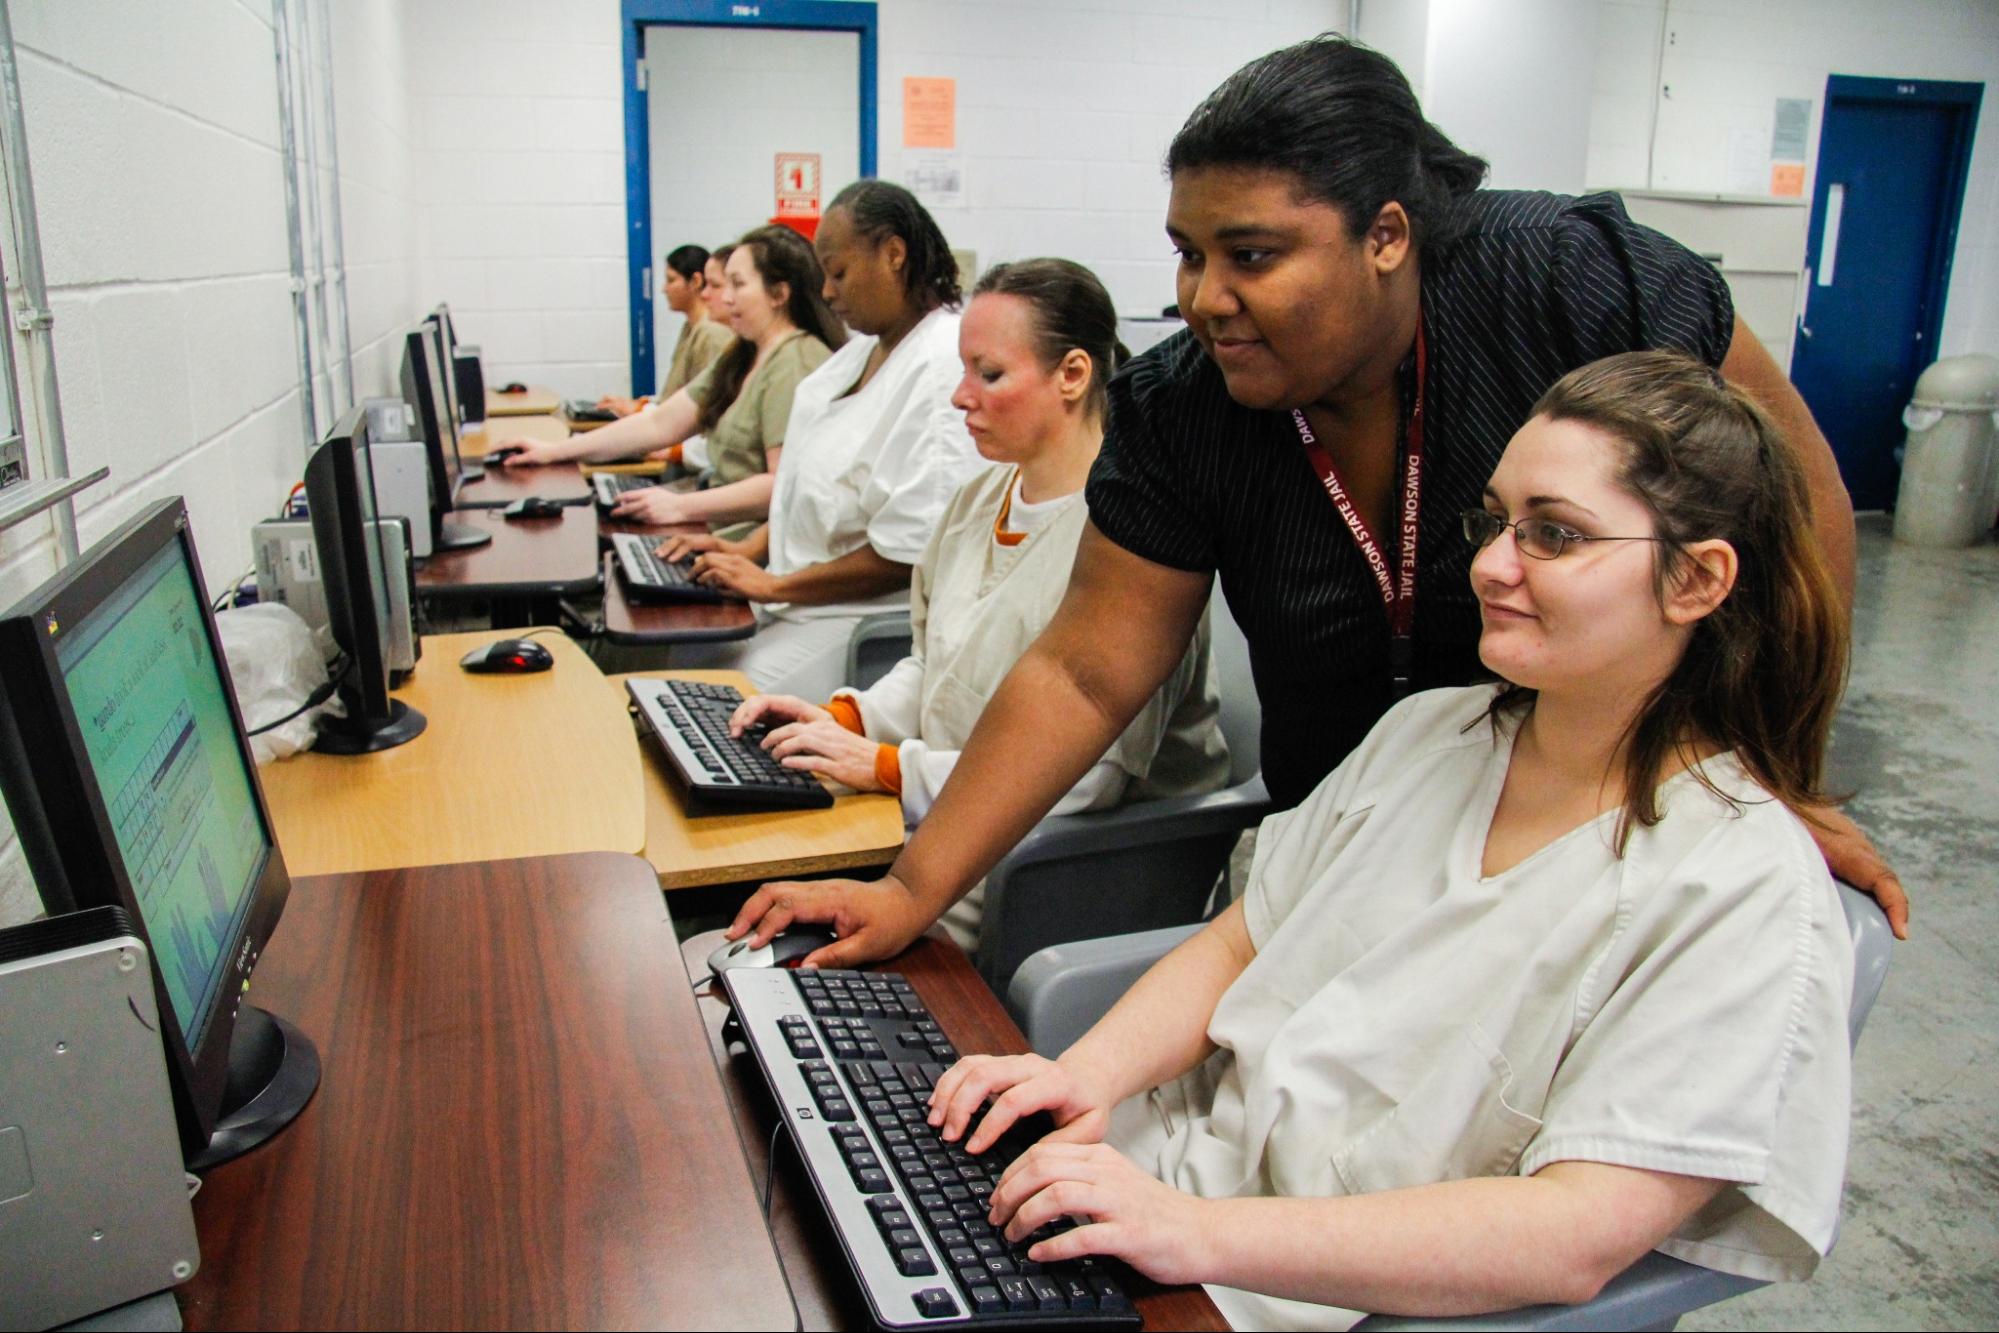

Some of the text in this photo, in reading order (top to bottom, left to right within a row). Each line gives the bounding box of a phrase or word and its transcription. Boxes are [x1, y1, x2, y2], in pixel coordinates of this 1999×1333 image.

[1292, 408, 1315, 444] DAWS
[1323, 470, 1395, 603] DAWSON STATE JAIL
[1399, 455, 1419, 600] DAWSON STATE JAIL
